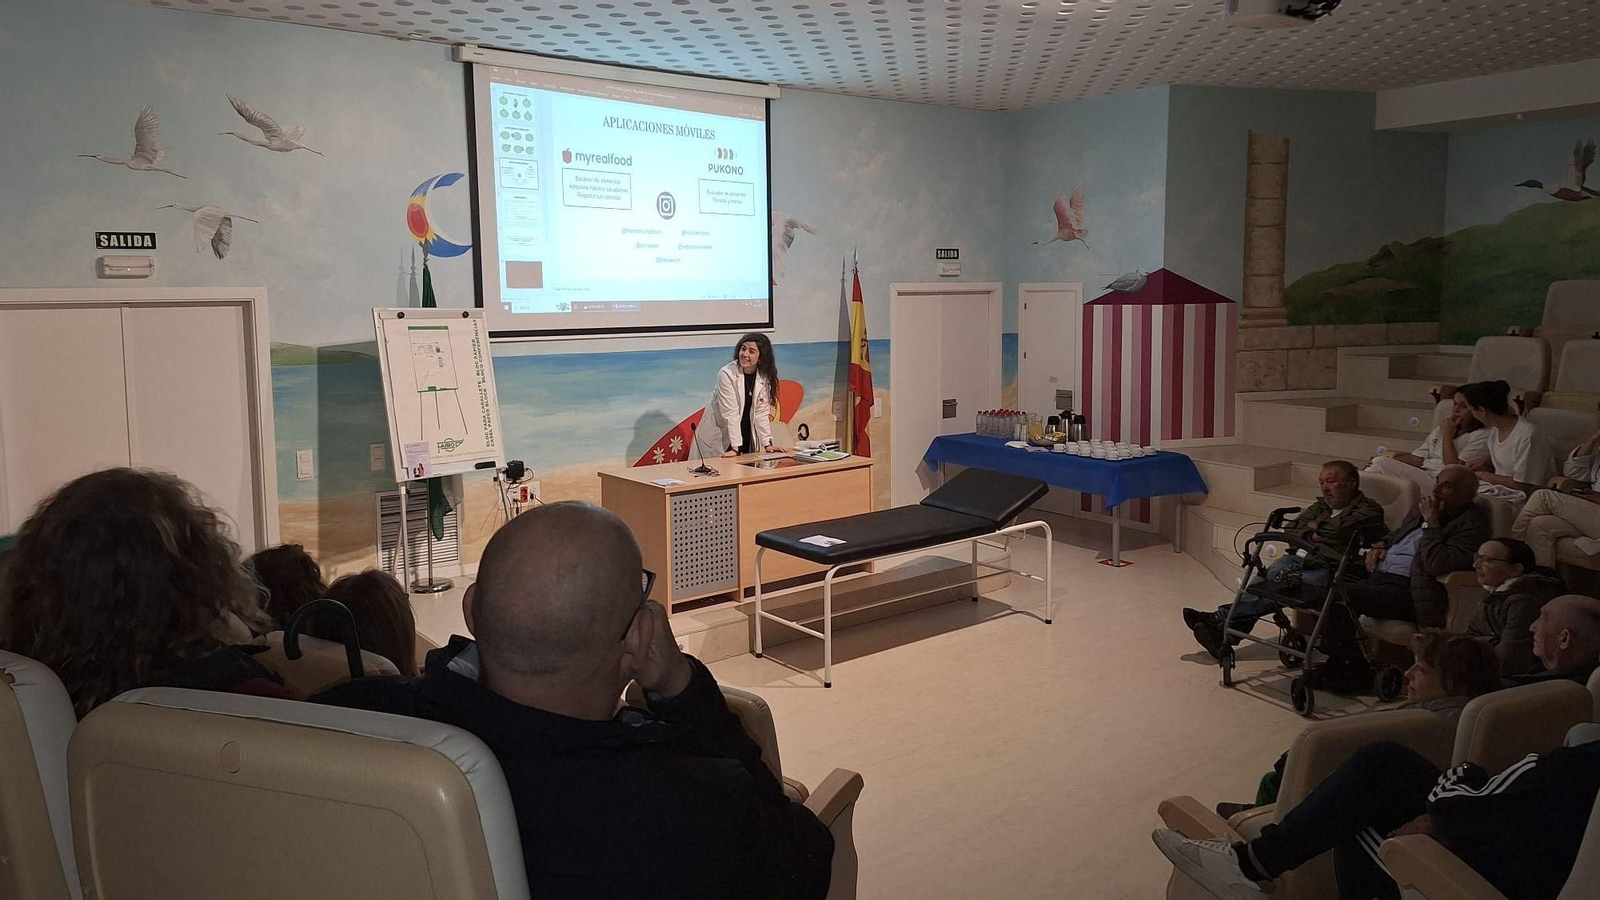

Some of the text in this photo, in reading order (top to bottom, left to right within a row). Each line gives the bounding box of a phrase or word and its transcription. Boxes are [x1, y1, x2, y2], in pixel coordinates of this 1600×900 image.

[603, 116, 716, 140] APLICACIONES MÓVILES
[575, 152, 633, 167] myrealfood
[708, 163, 744, 175] PUKONO
[100, 234, 152, 247] SALIDA
[937, 250, 958, 258] SALIDA
